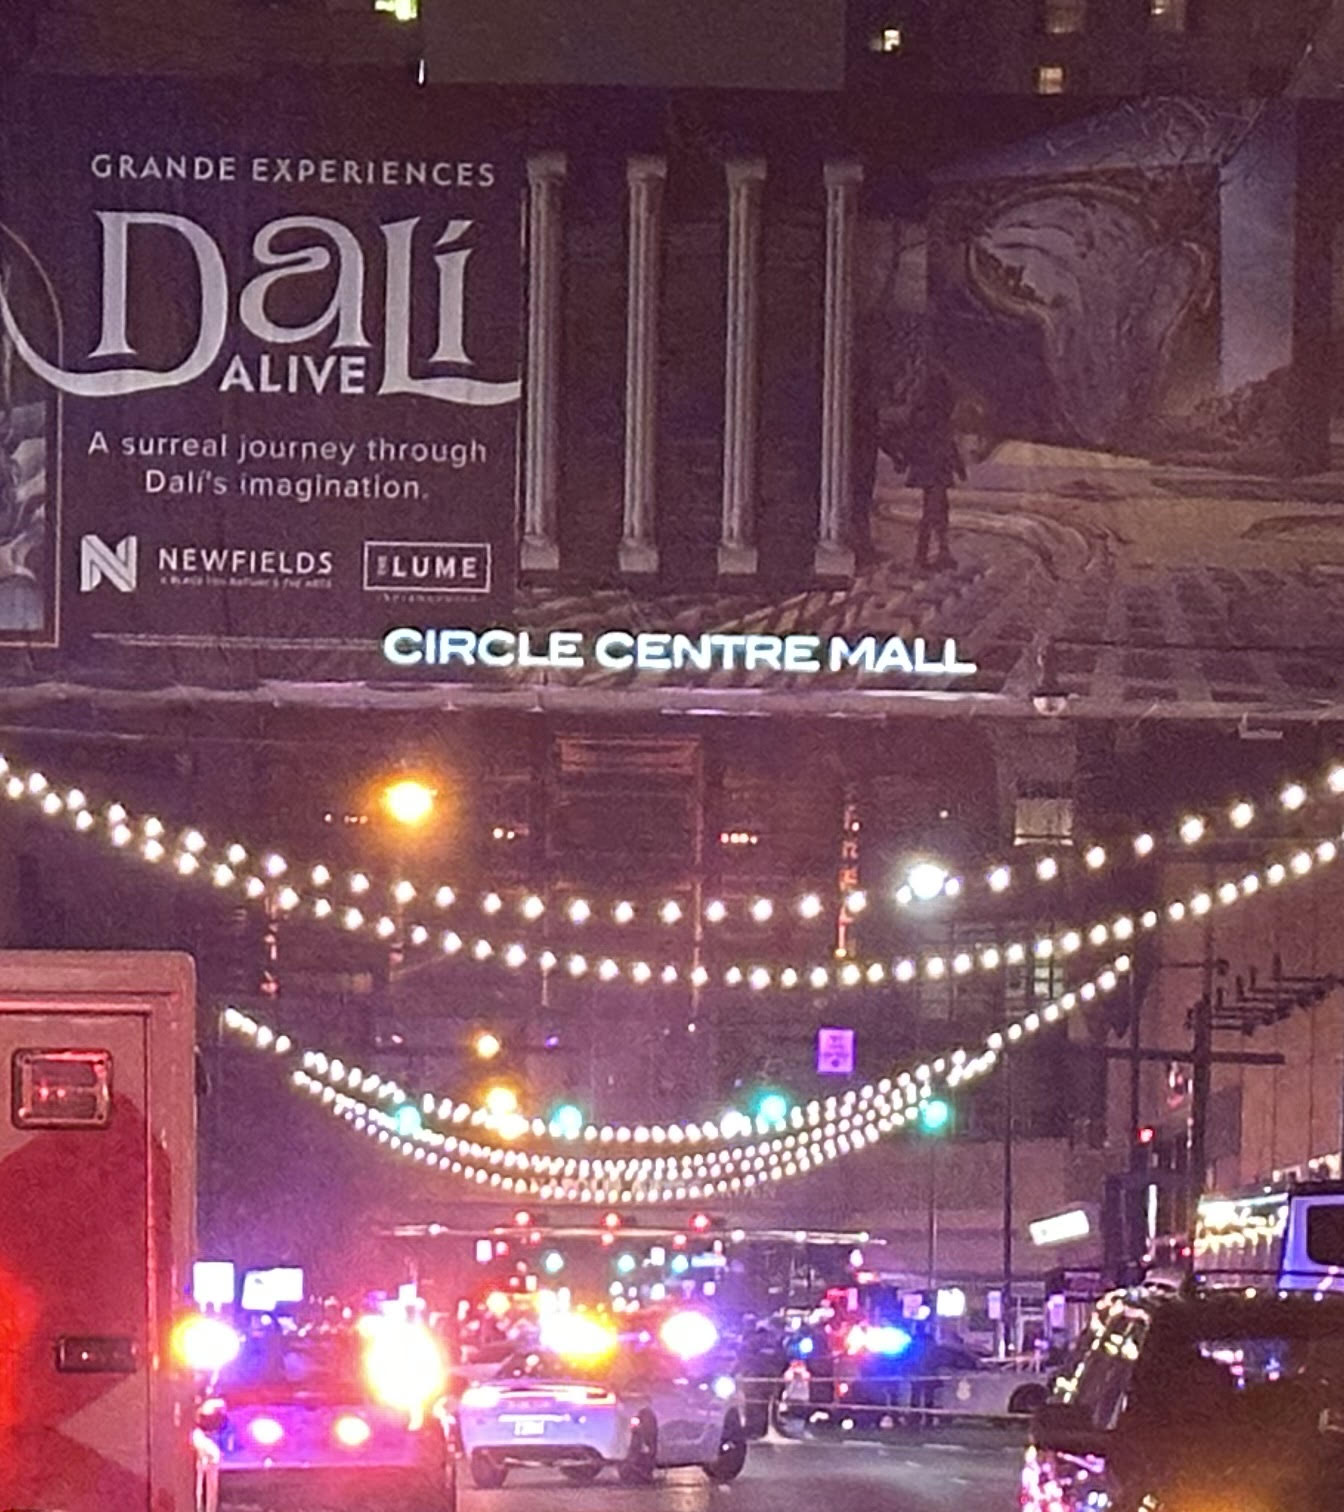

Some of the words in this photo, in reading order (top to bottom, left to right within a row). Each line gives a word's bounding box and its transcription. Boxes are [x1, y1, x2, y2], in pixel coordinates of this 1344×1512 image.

[90, 154, 235, 181] GRANDE
[252, 158, 495, 187] EXPERIENCES
[219, 353, 366, 394] ALIVE
[88, 431, 109, 454] A
[122, 434, 227, 457] surreal
[237, 436, 356, 465] journey
[367, 437, 487, 468] through
[145, 468, 228, 494] Dalí's
[240, 473, 429, 503] imagination.
[159, 548, 333, 573] NEWFIELDS
[392, 555, 477, 579] LUME
[382, 628, 583, 668] CIRCLE
[594, 631, 821, 672] CENTRE
[829, 636, 977, 674] MALL
